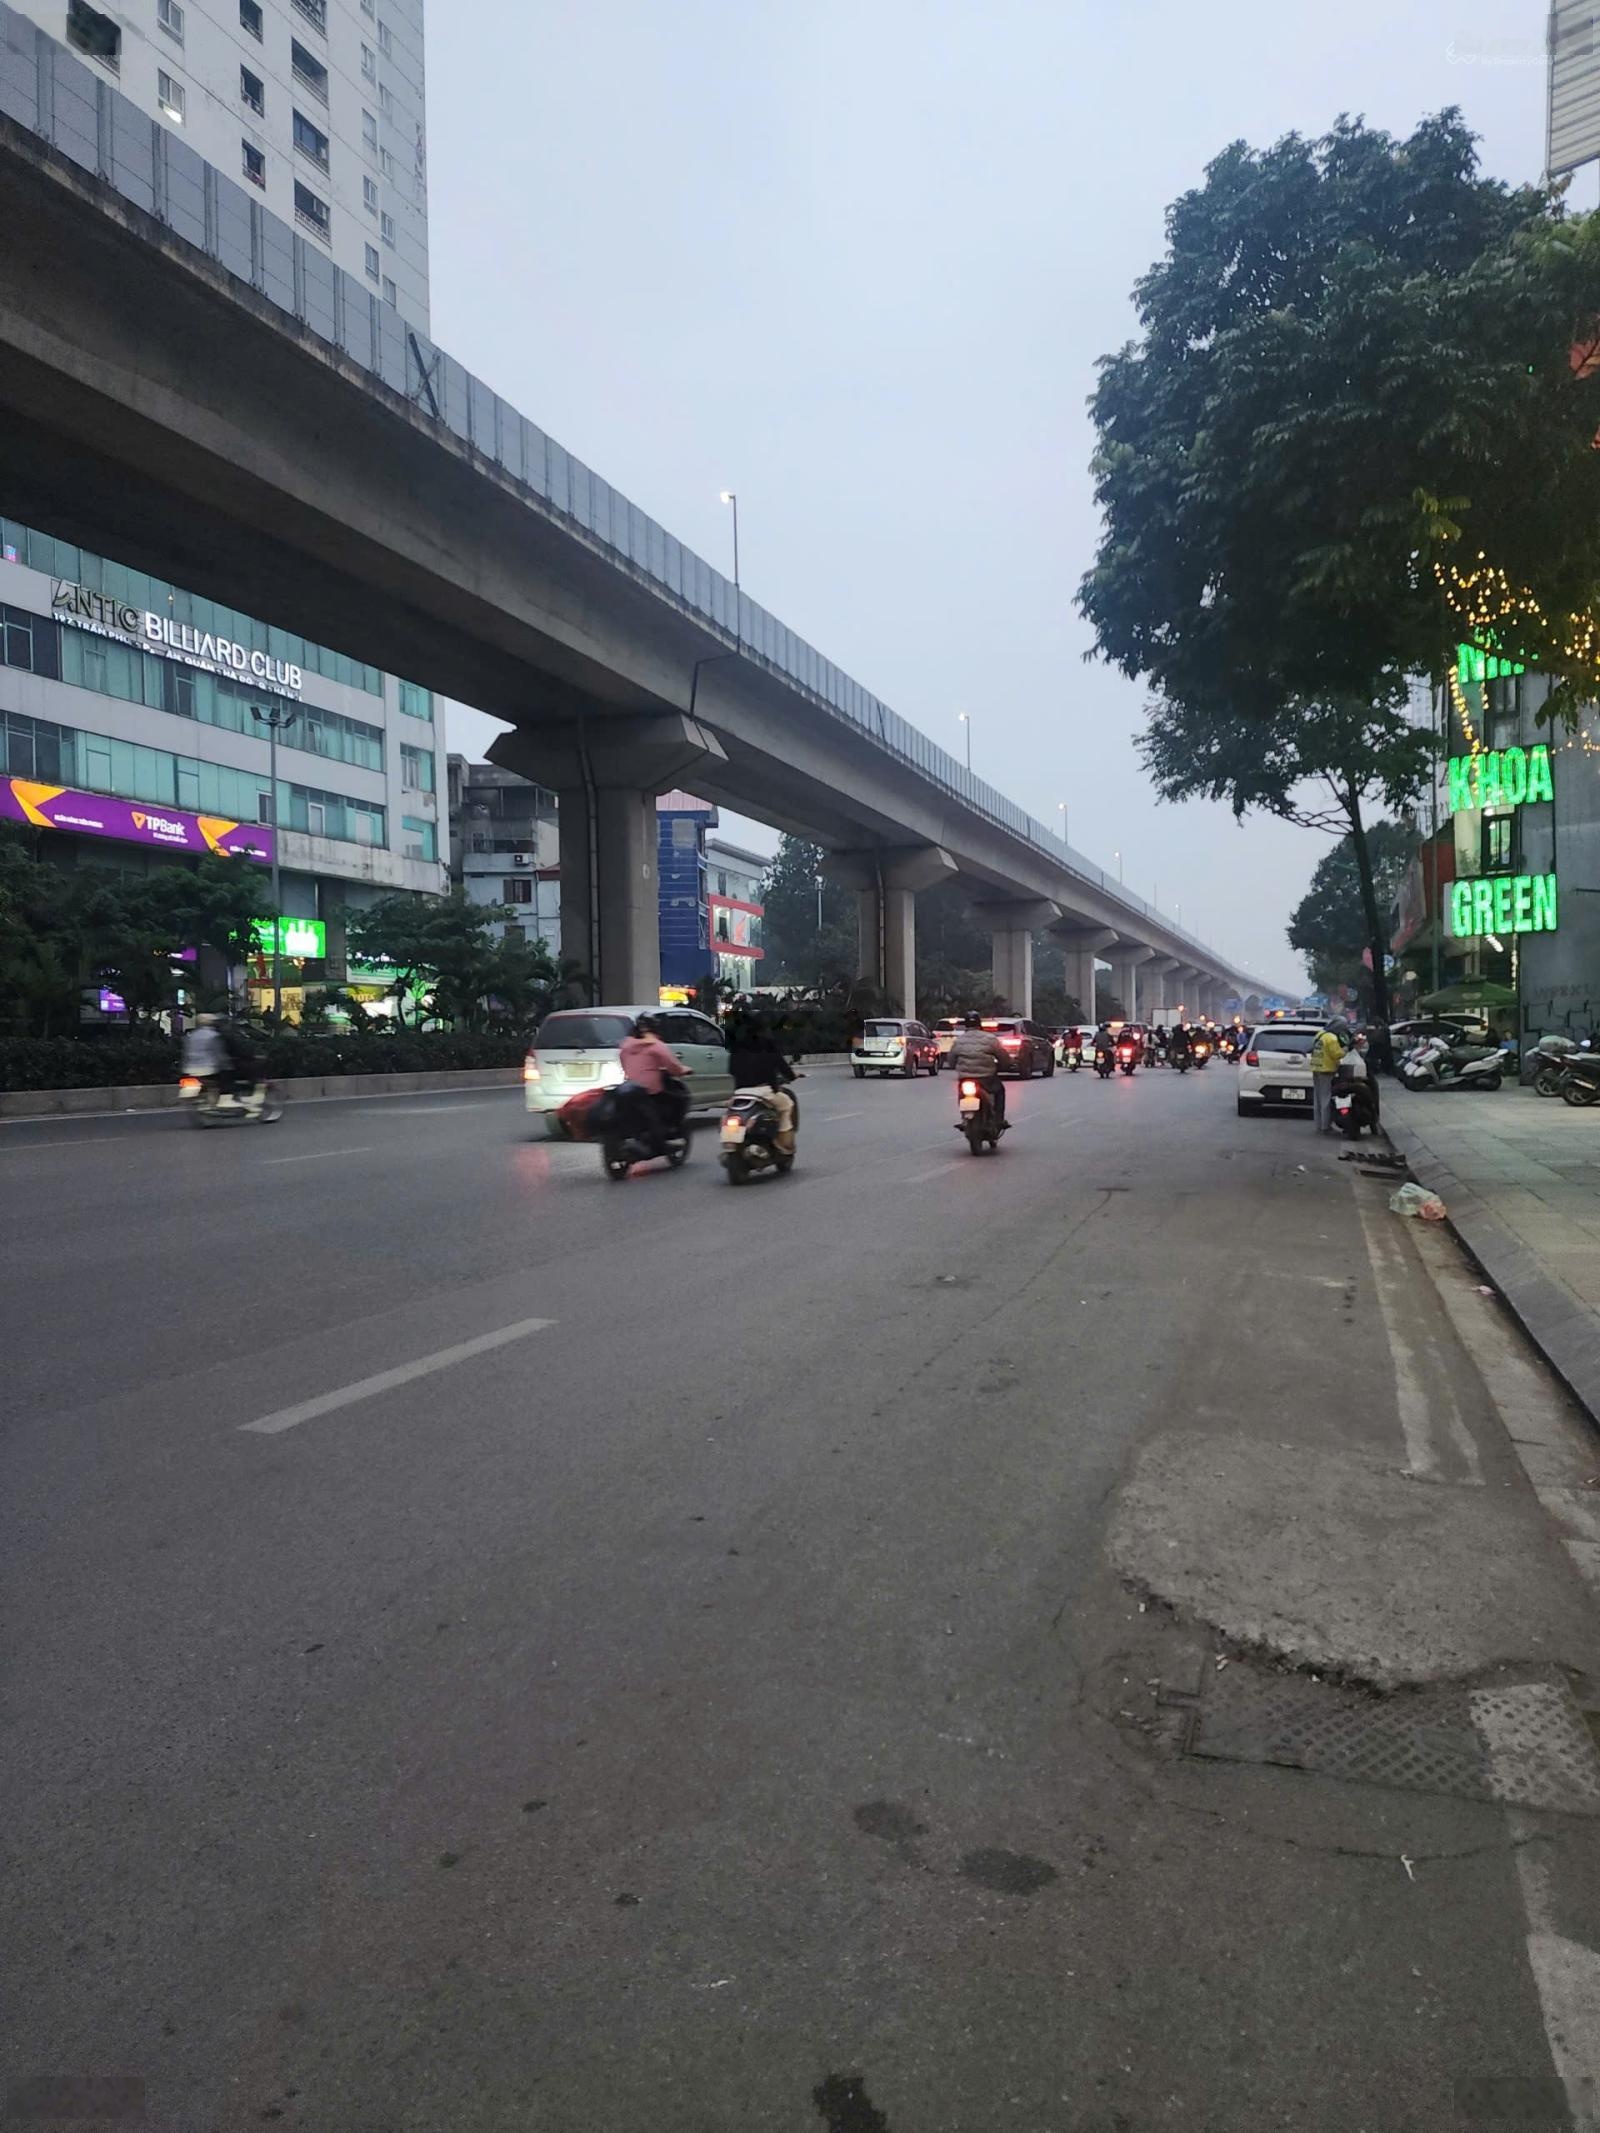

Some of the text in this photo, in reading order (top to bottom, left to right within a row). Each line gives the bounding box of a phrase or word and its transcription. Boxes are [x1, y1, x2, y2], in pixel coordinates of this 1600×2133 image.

[52, 579, 303, 690] ANTIC BILLIARD CLUB
[1448, 744, 1554, 812] KHOA
[145, 815, 185, 836] TPBank
[1451, 873, 1557, 937] GREEN
